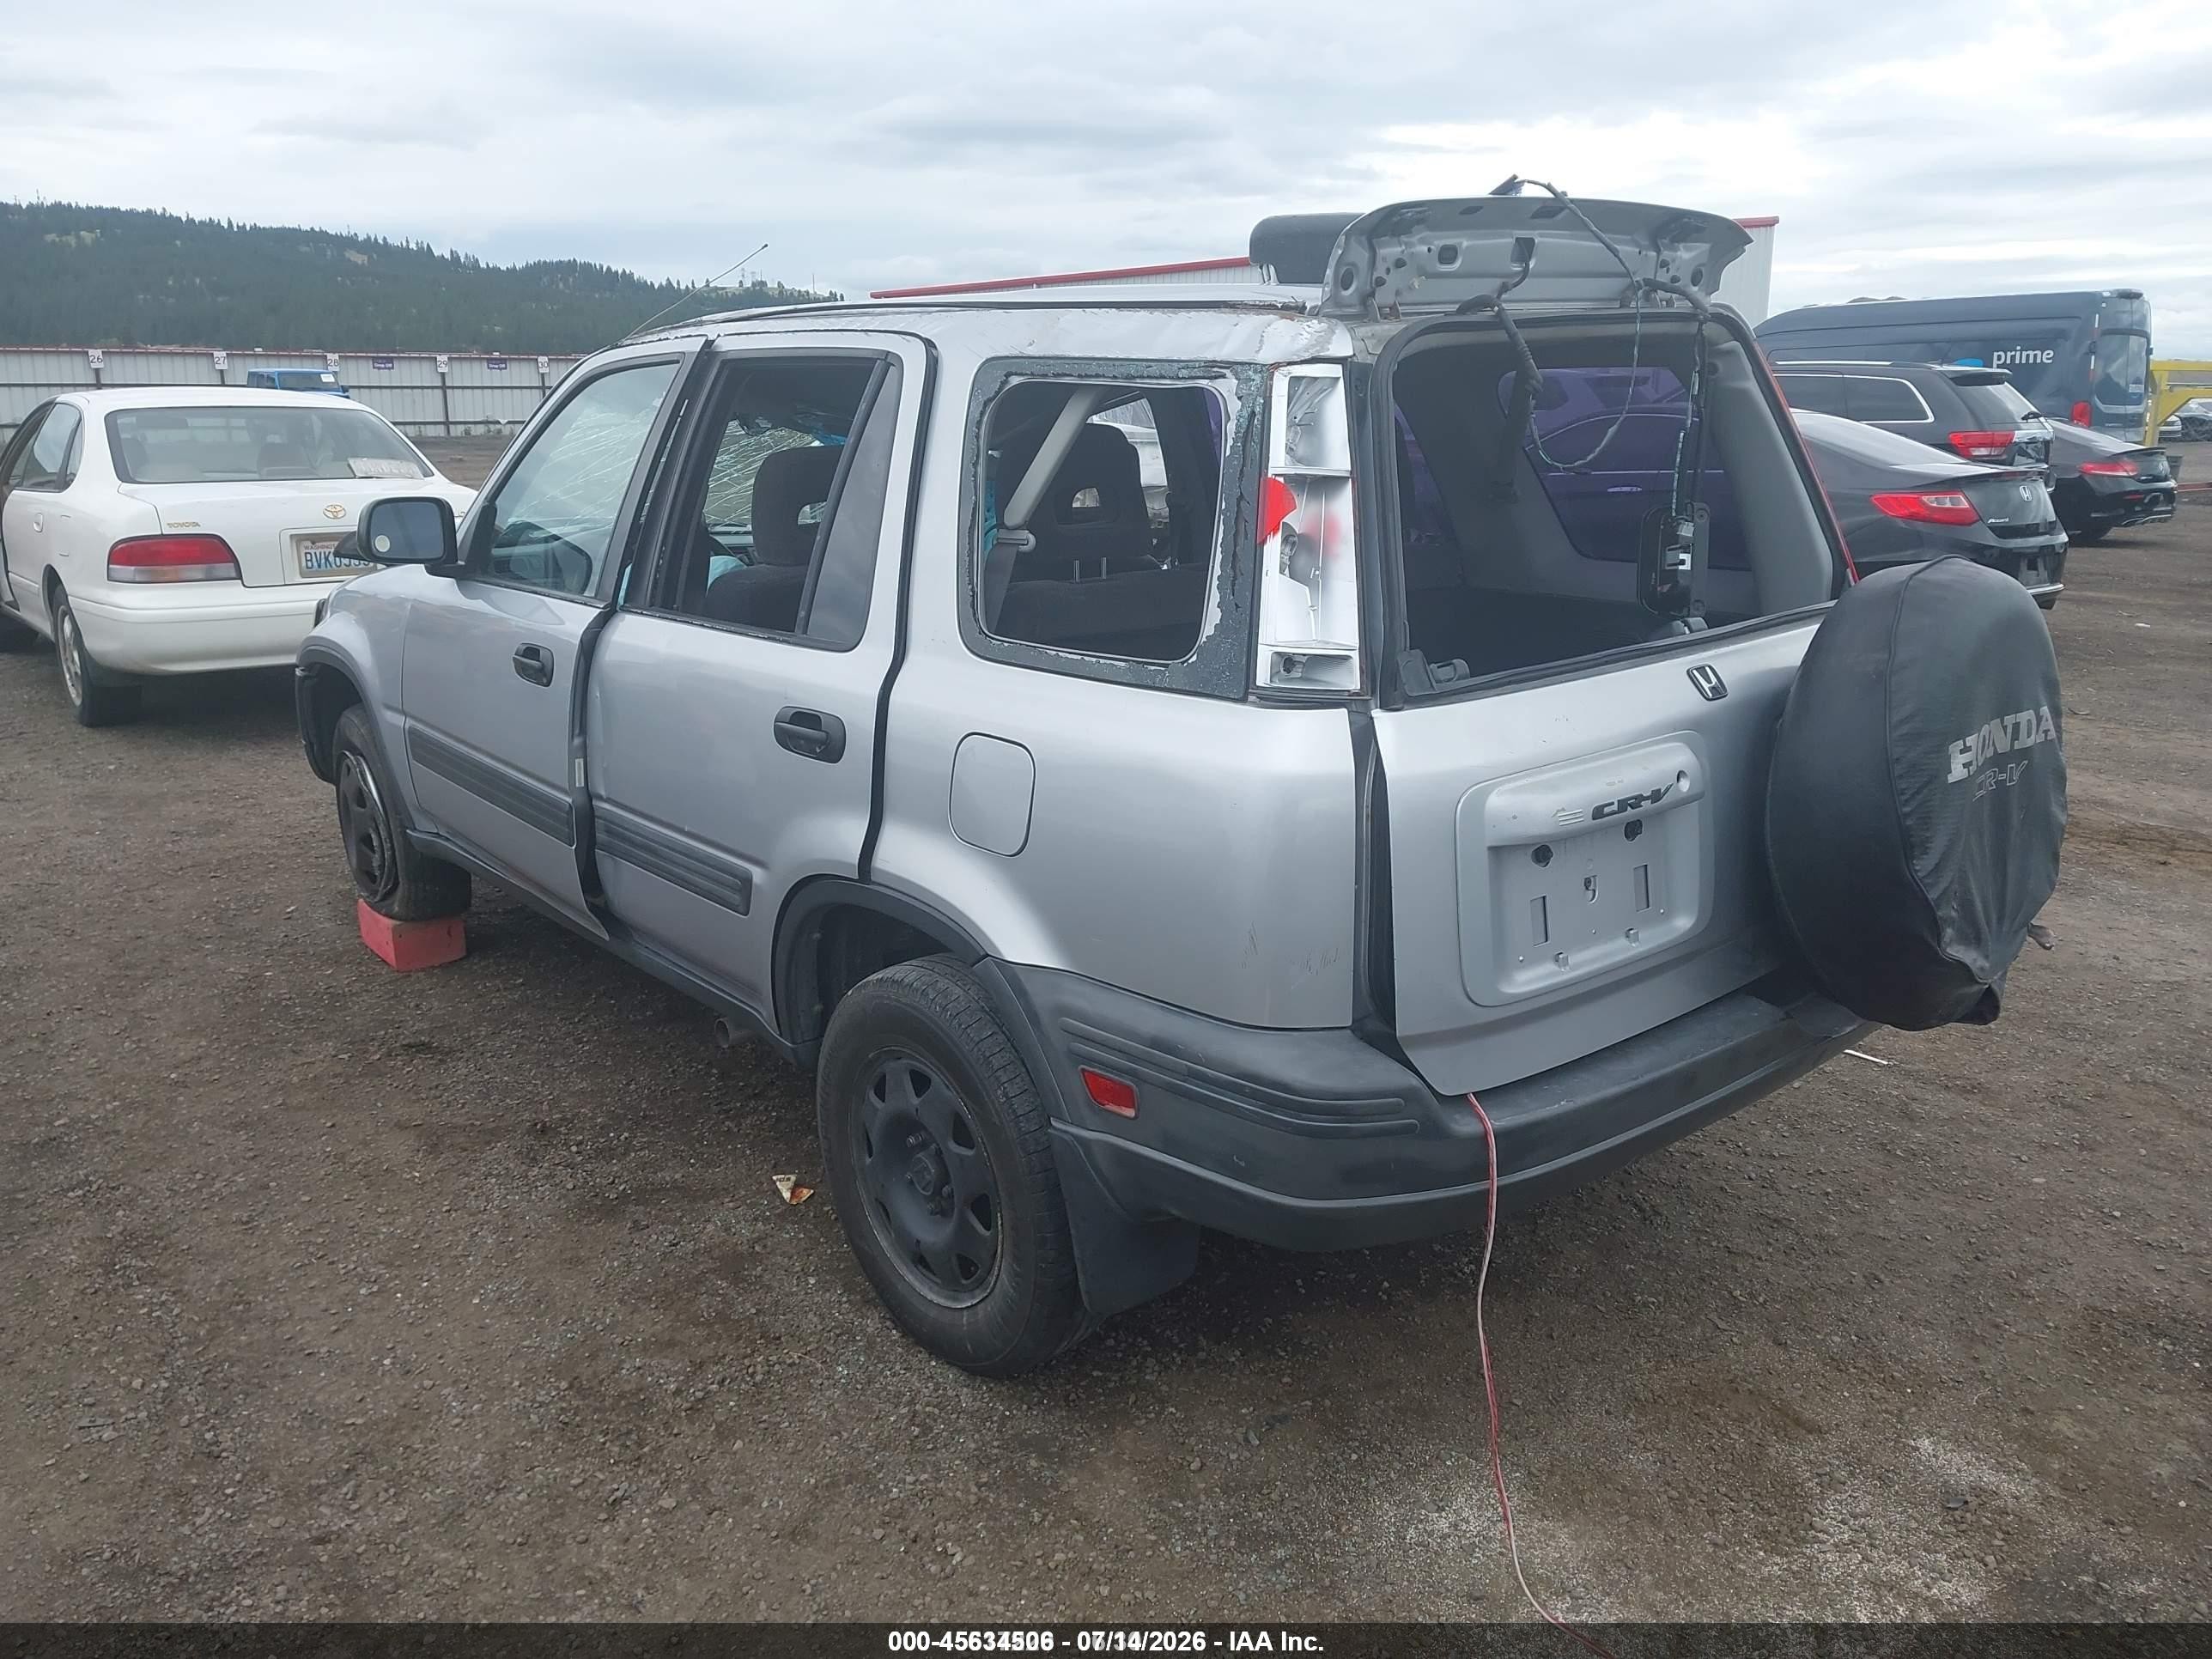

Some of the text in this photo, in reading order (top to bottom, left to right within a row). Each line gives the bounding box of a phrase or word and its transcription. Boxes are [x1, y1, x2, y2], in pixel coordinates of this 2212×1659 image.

[89, 355, 103, 363] 26
[215, 356, 227, 365] 27
[1992, 345, 2054, 369] prime
[1947, 706, 2057, 784] HONDA
[1591, 782, 1674, 821] CR-V
